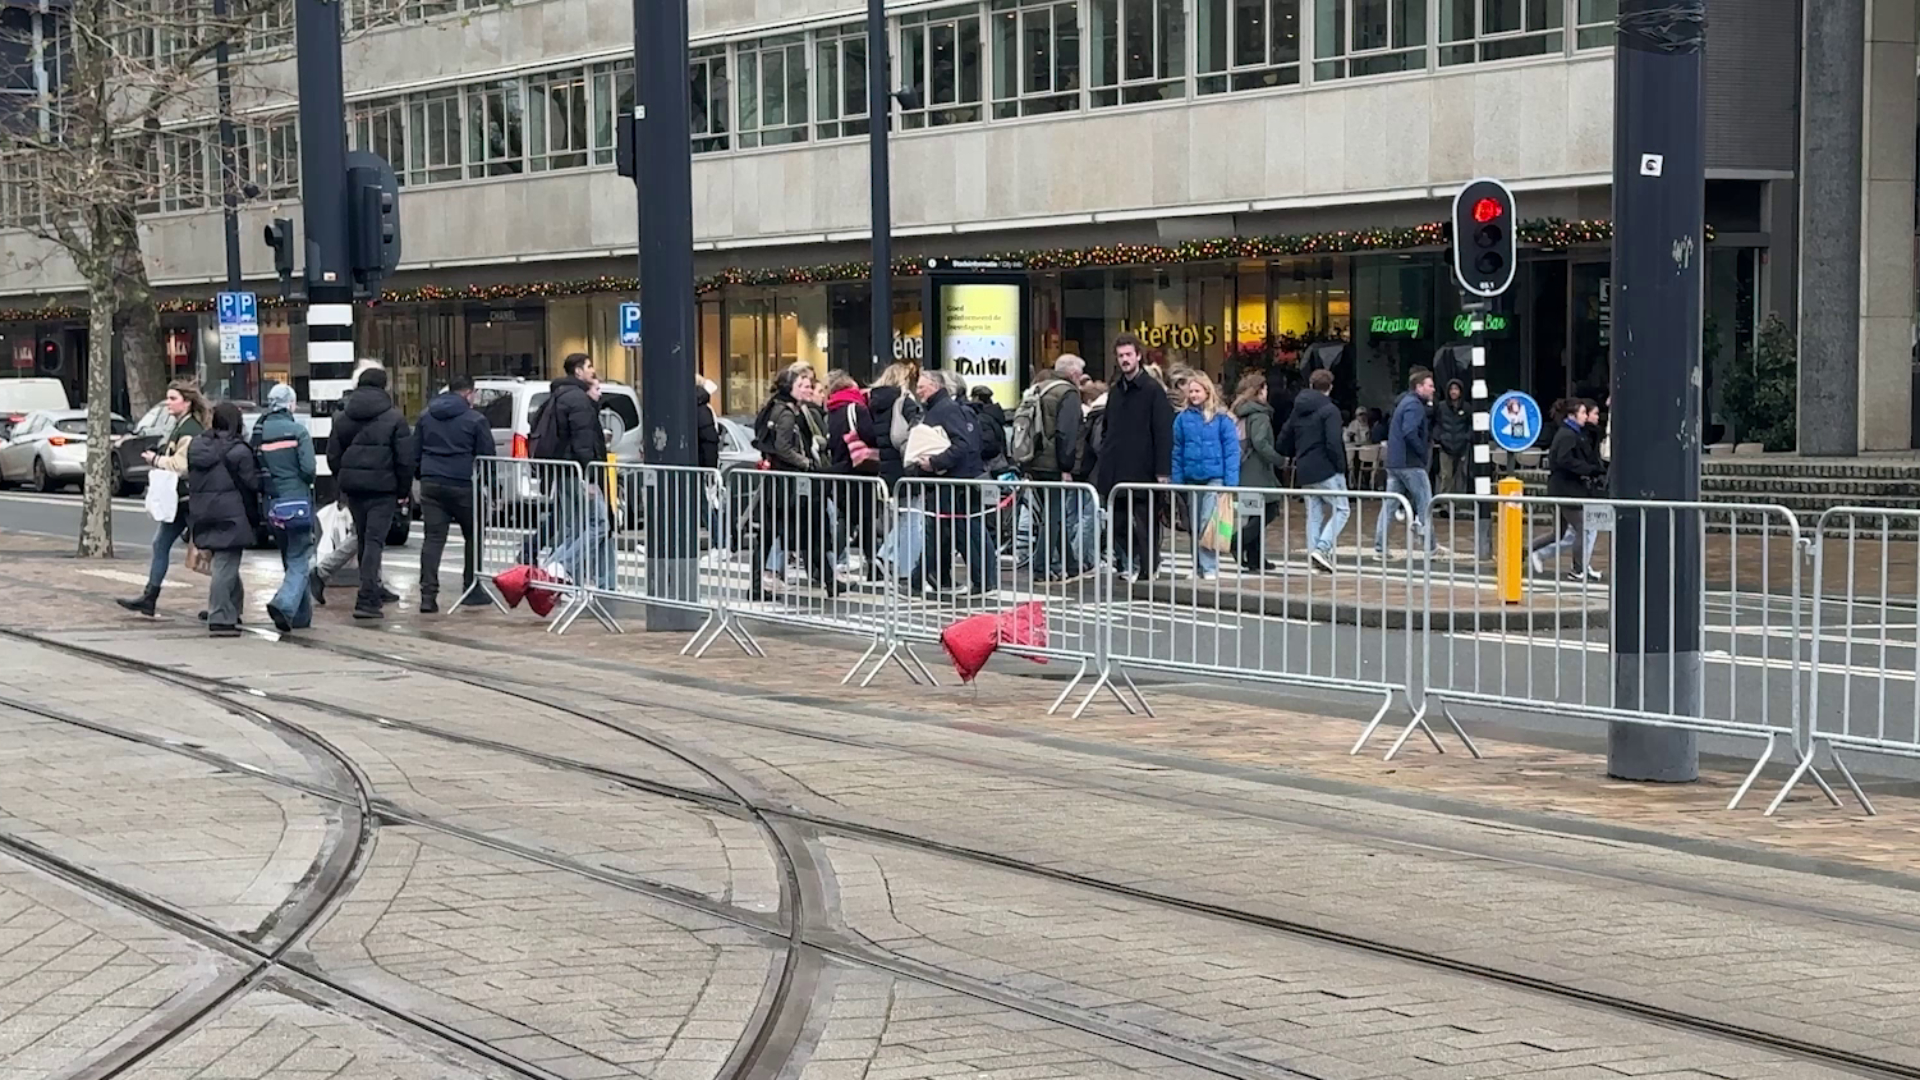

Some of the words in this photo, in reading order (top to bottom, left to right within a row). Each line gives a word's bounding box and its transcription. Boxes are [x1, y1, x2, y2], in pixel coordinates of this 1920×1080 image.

[222, 295, 233, 312] P
[241, 295, 252, 312] P
[626, 307, 641, 328] P
[1484, 314, 1506, 331] Bar
[1370, 315, 1420, 339] Takeaway
